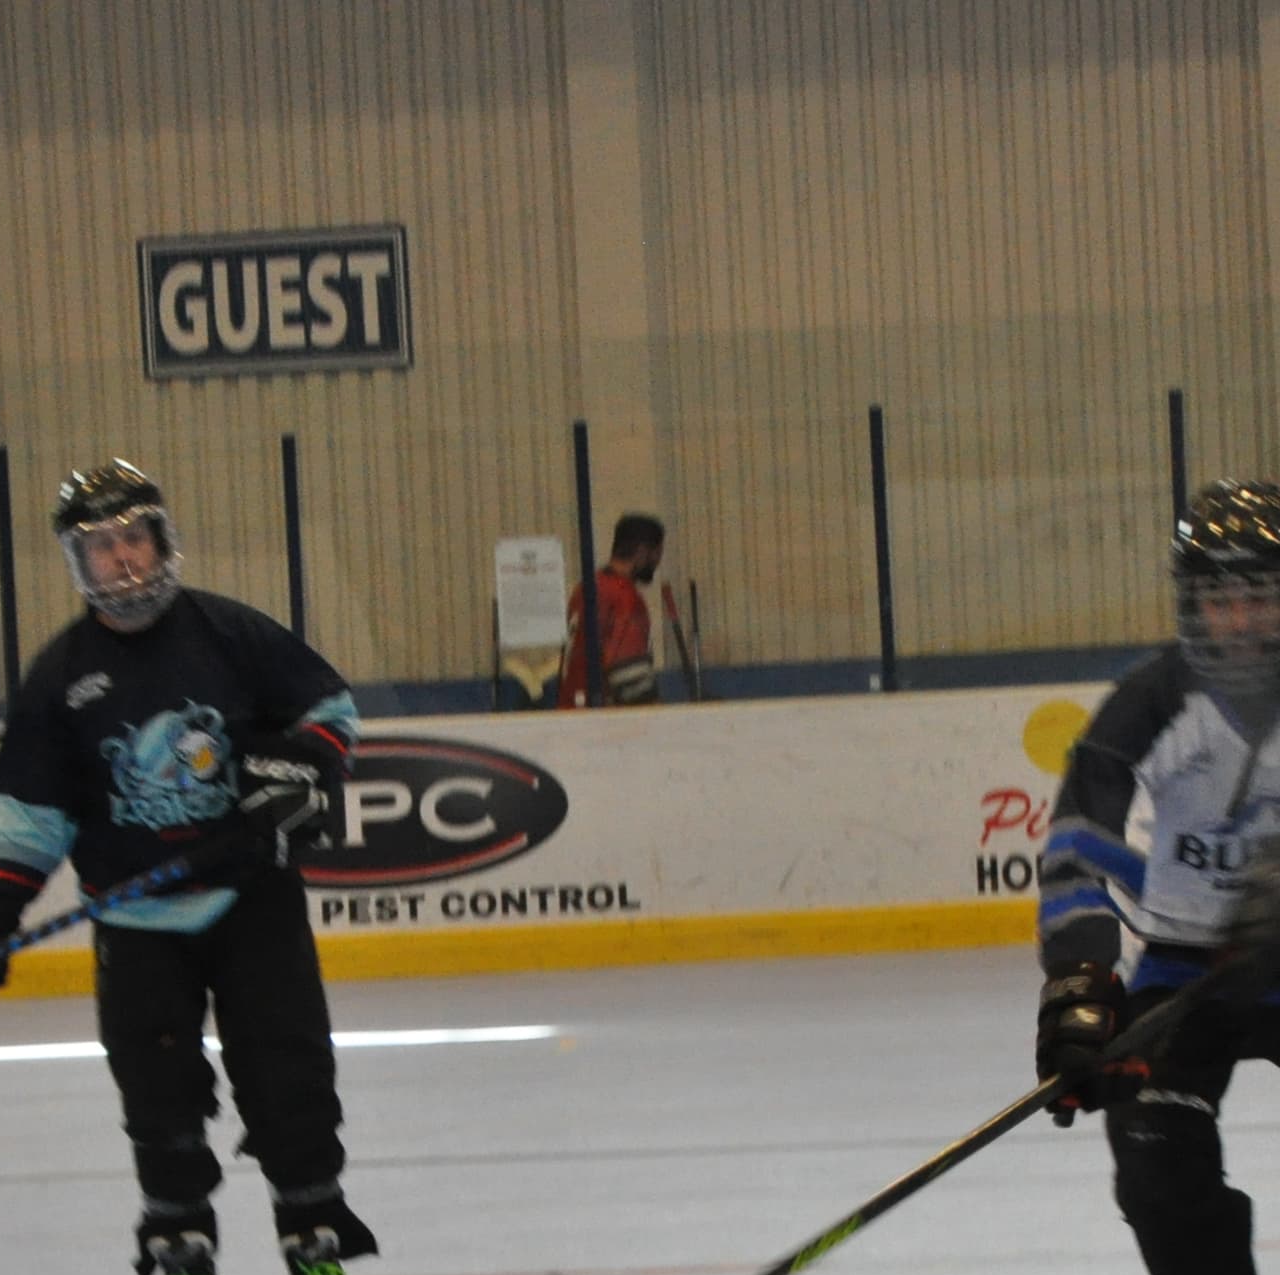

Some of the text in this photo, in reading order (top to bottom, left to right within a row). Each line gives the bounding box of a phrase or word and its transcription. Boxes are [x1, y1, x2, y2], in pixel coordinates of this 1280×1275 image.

[158, 252, 390, 356] GUEST
[322, 884, 640, 925] PEST CONTROL
